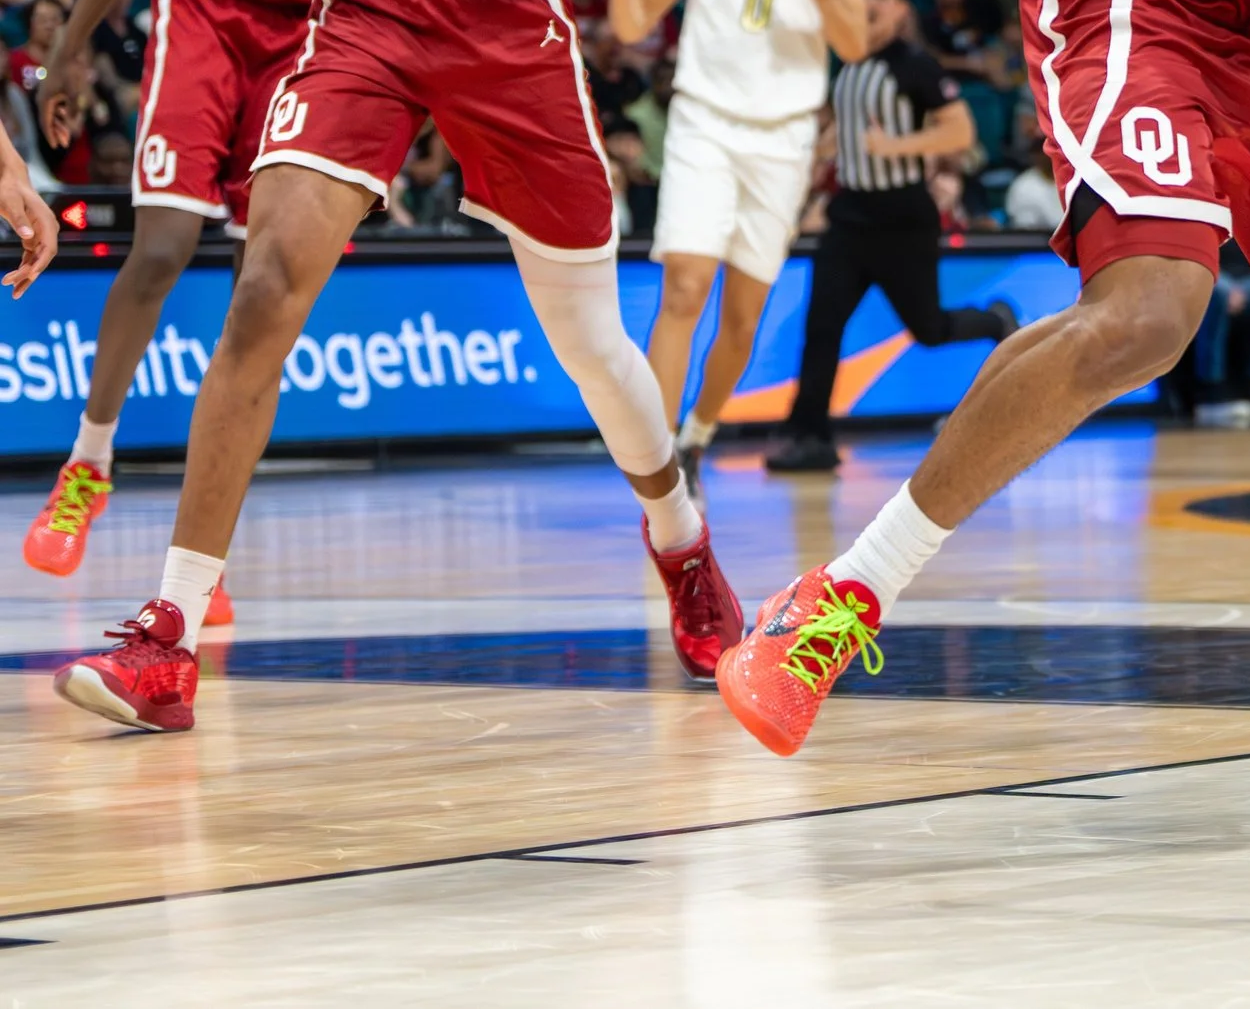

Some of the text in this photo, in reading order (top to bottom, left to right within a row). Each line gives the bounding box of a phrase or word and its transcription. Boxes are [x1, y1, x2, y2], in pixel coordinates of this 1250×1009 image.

[270, 91, 308, 141] OU
[1121, 106, 1193, 186] OU
[143, 134, 177, 187] OU
[279, 311, 537, 409] ogether.
